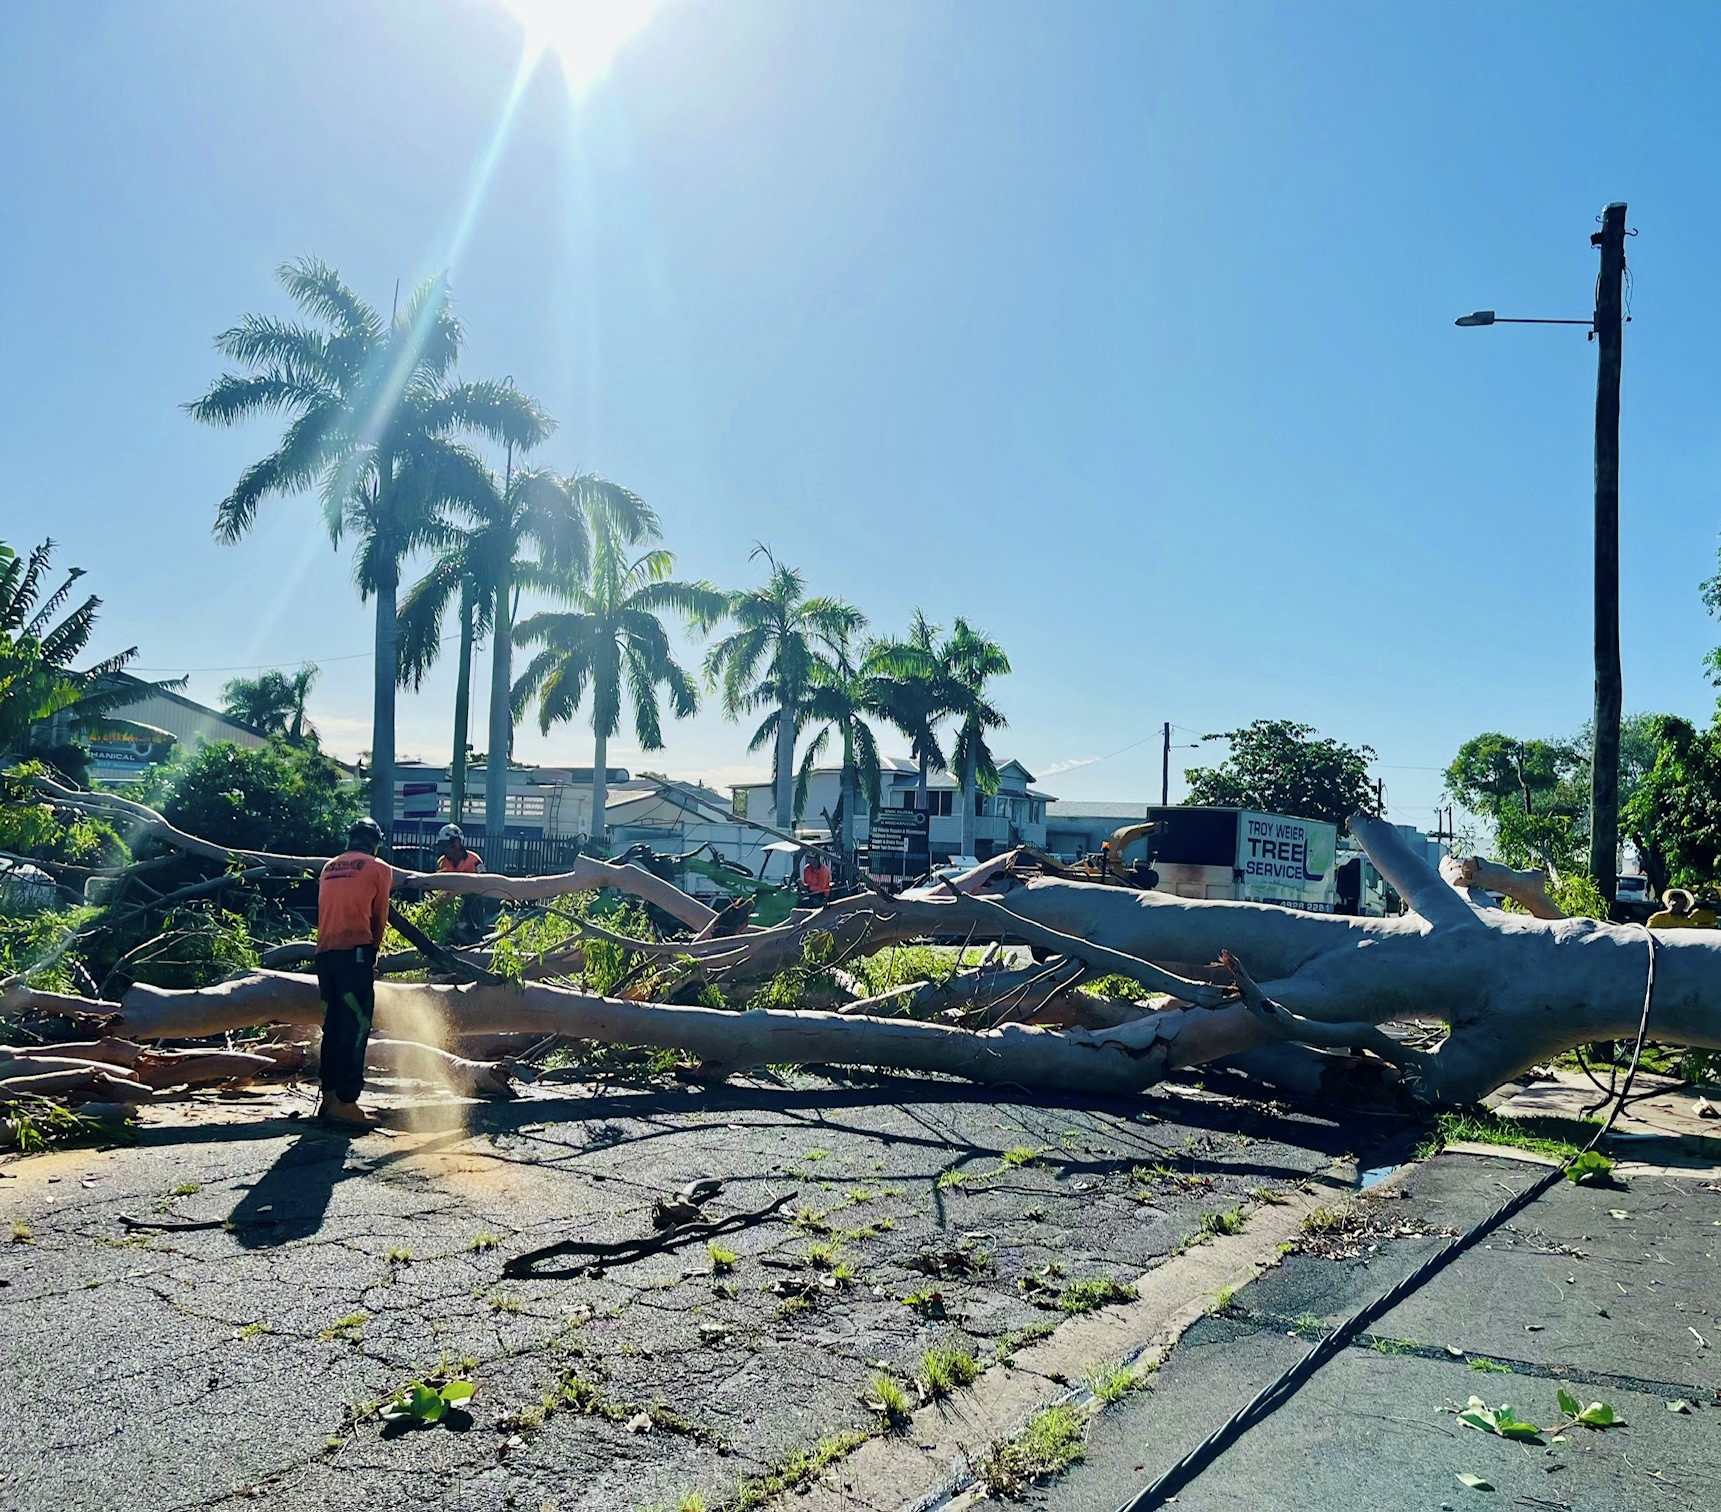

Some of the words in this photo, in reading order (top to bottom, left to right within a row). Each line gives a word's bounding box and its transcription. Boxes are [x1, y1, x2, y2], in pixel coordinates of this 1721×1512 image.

[1248, 820, 1274, 837] TROY
[1275, 823, 1304, 841] WEIER
[1247, 837, 1303, 863] TREE
[1246, 861, 1302, 880] SERVICE
